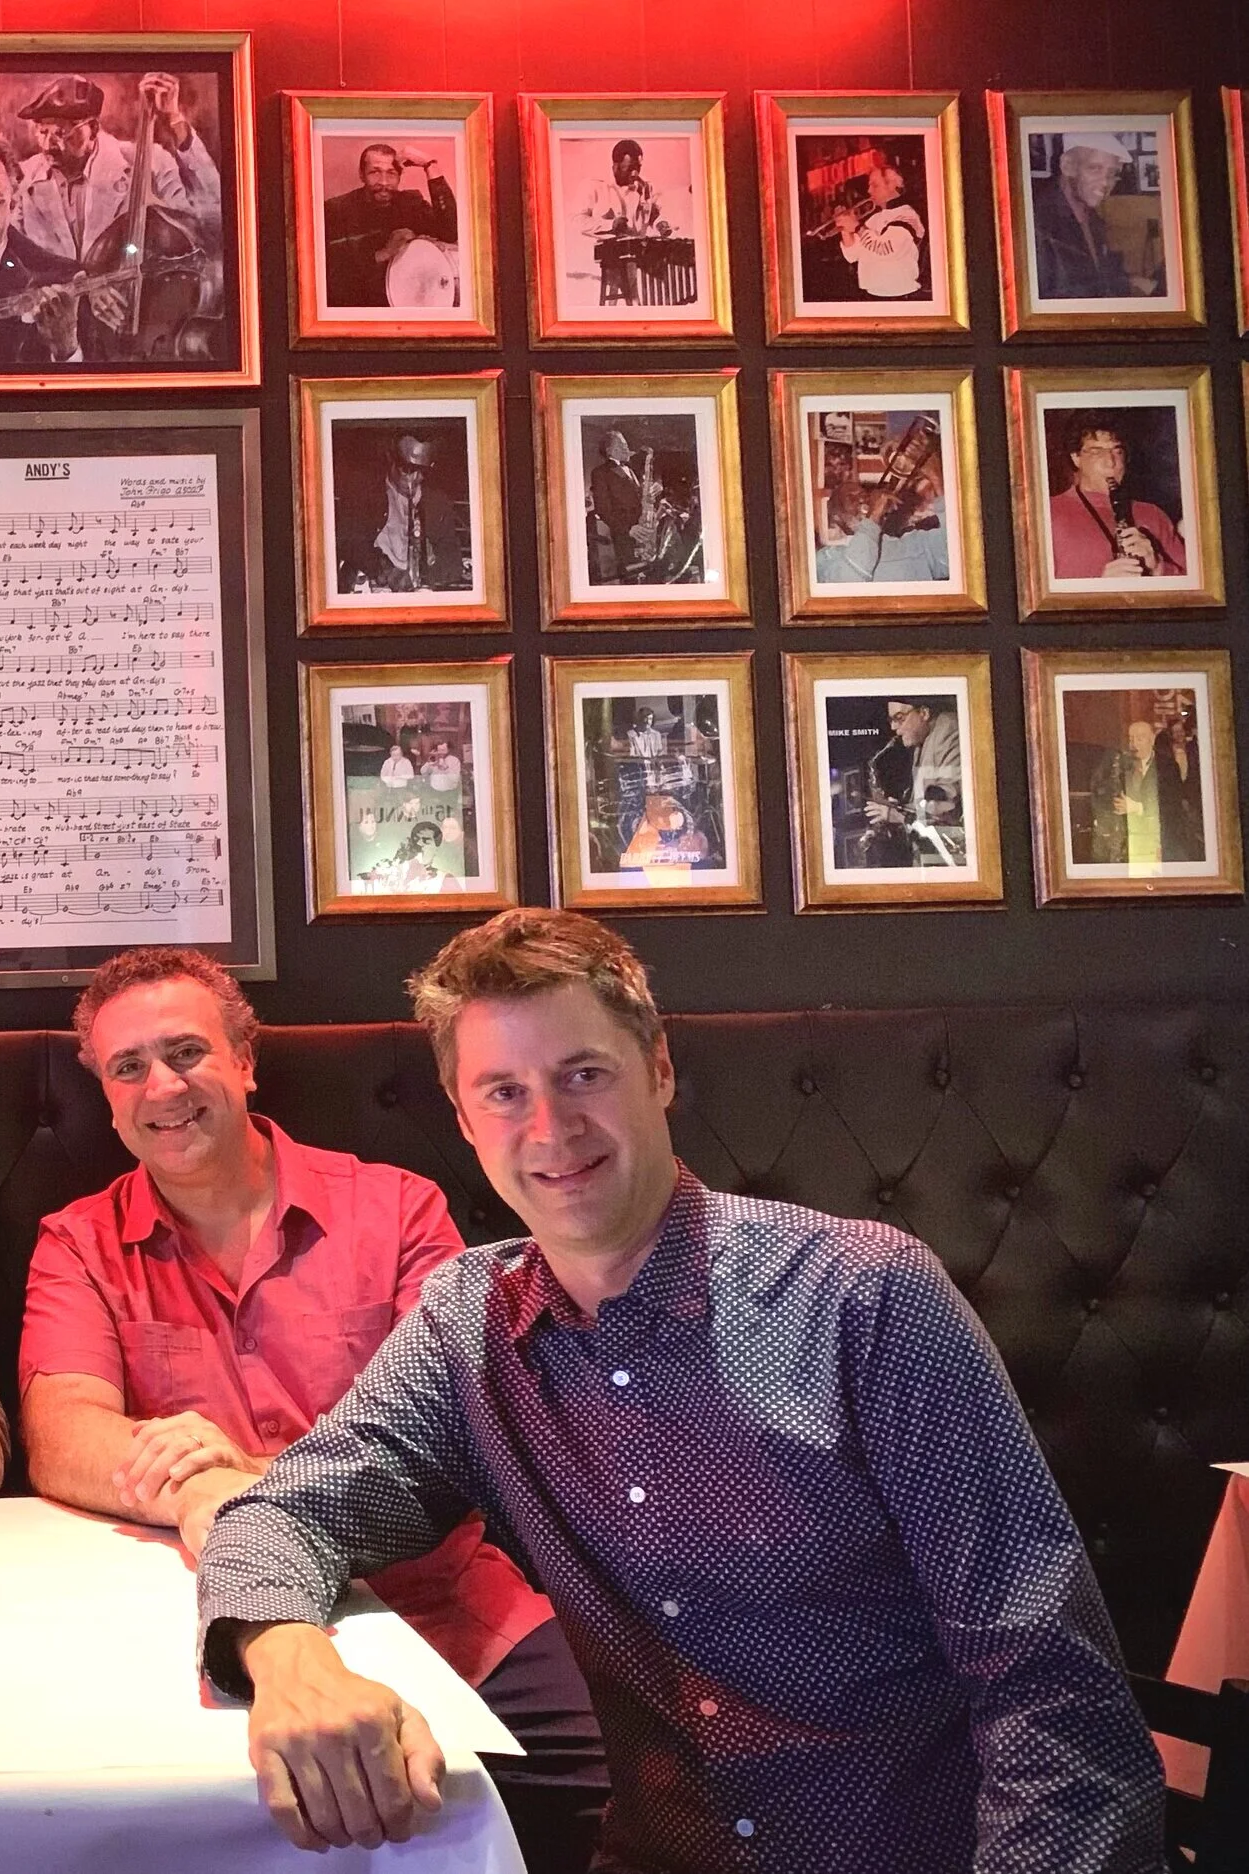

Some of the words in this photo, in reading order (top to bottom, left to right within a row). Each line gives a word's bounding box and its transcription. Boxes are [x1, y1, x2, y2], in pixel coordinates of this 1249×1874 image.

[25, 463, 70, 476] ANDY'S
[196, 477, 206, 485] by
[120, 488, 144, 496] John
[91, 585, 100, 594] of
[104, 585, 126, 594] sight
[172, 632, 185, 640] say
[66, 677, 79, 687] they
[82, 678, 96, 688] play
[98, 677, 116, 685] down
[120, 676, 129, 685] at
[112, 725, 130, 733] hard
[132, 725, 145, 736] day
[176, 723, 192, 731] have
[158, 821, 166, 829] of
[201, 819, 222, 828] and
[32, 872, 54, 881] great
